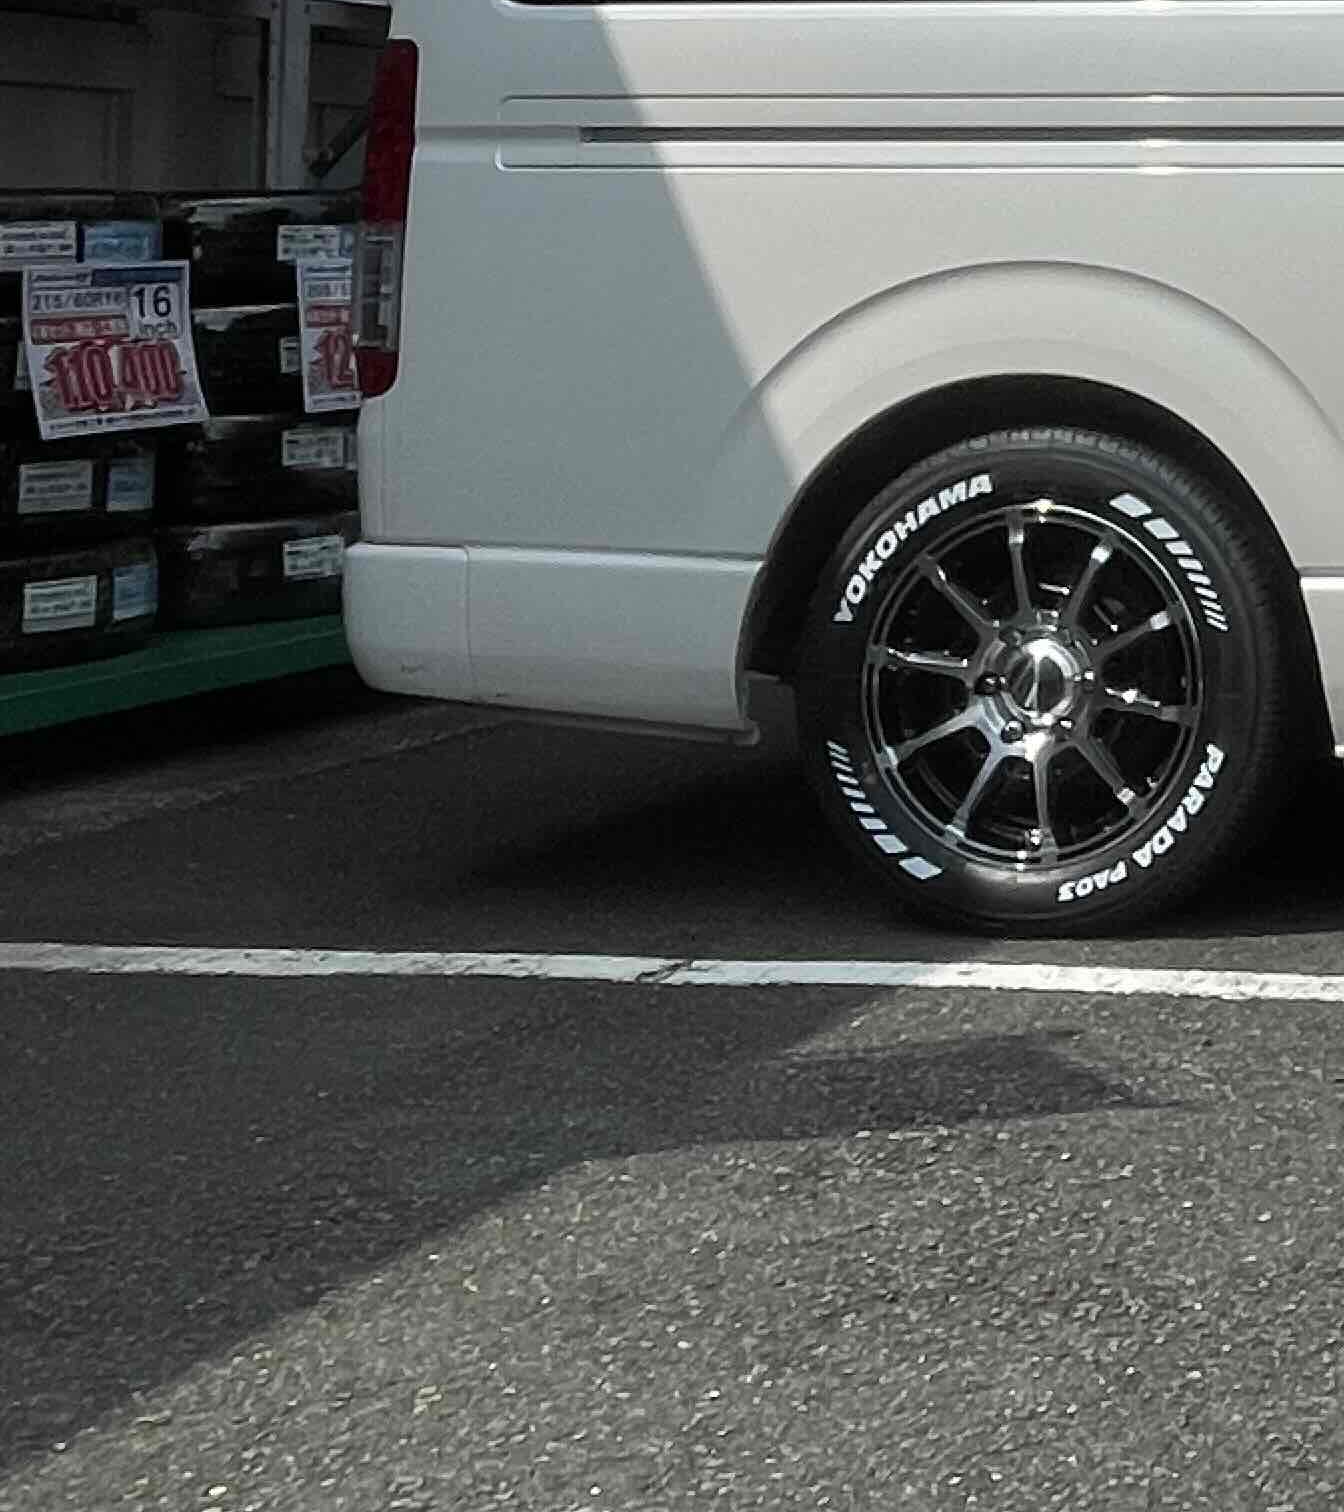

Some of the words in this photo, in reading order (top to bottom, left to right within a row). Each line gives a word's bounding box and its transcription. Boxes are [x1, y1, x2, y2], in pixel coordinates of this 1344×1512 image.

[133, 286, 171, 318] 16
[832, 473, 993, 622] YOKOHAMA
[1131, 743, 1226, 869] PARADA
